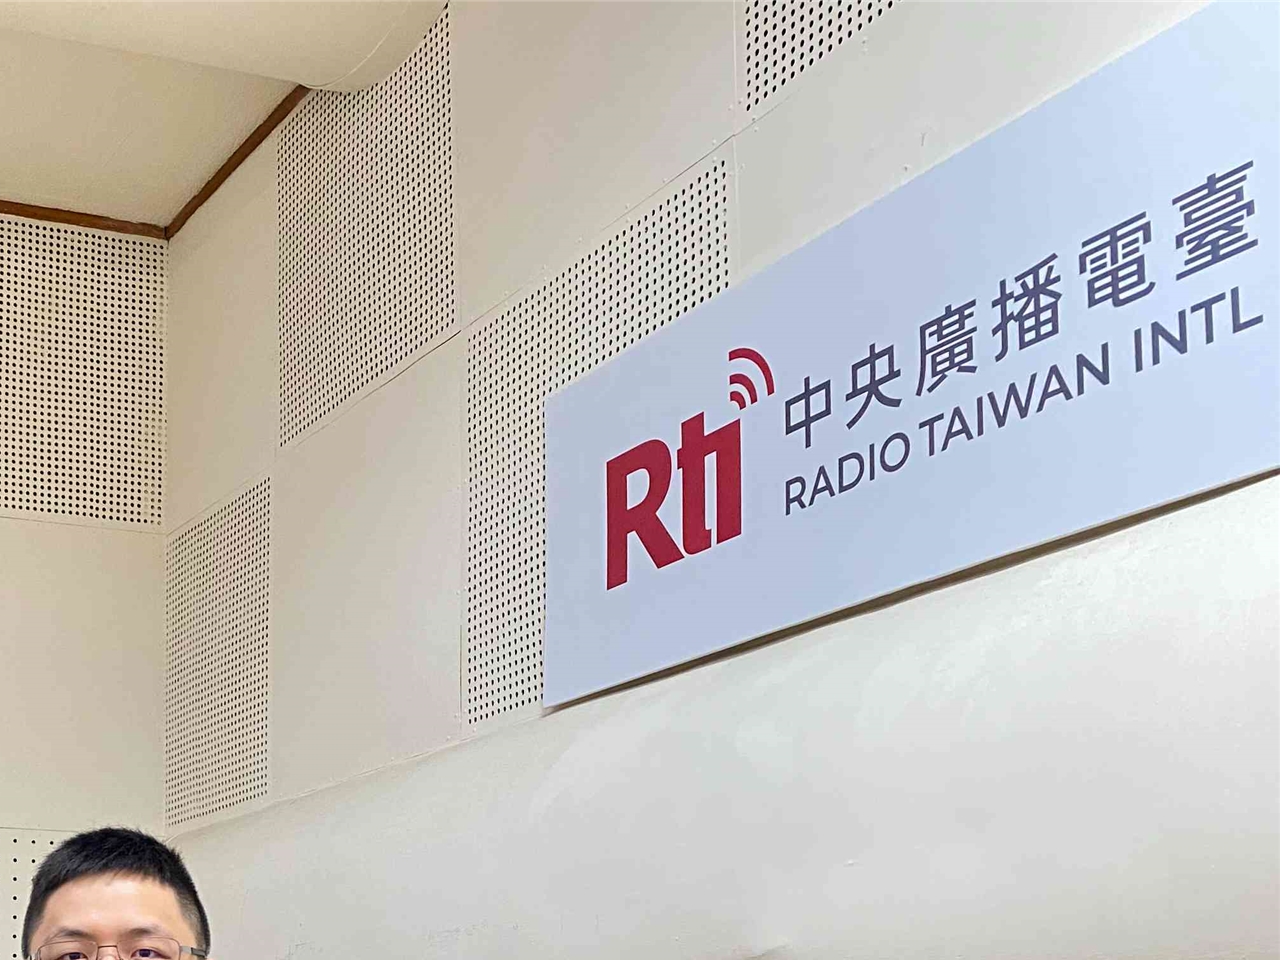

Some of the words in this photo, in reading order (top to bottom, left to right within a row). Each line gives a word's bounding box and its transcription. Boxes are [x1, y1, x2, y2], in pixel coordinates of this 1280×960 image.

[784, 160, 1259, 449] 中央廣播電臺
[784, 432, 911, 516] RADIO
[919, 342, 1111, 457] TAIWAN
[1133, 285, 1264, 374] INTL
